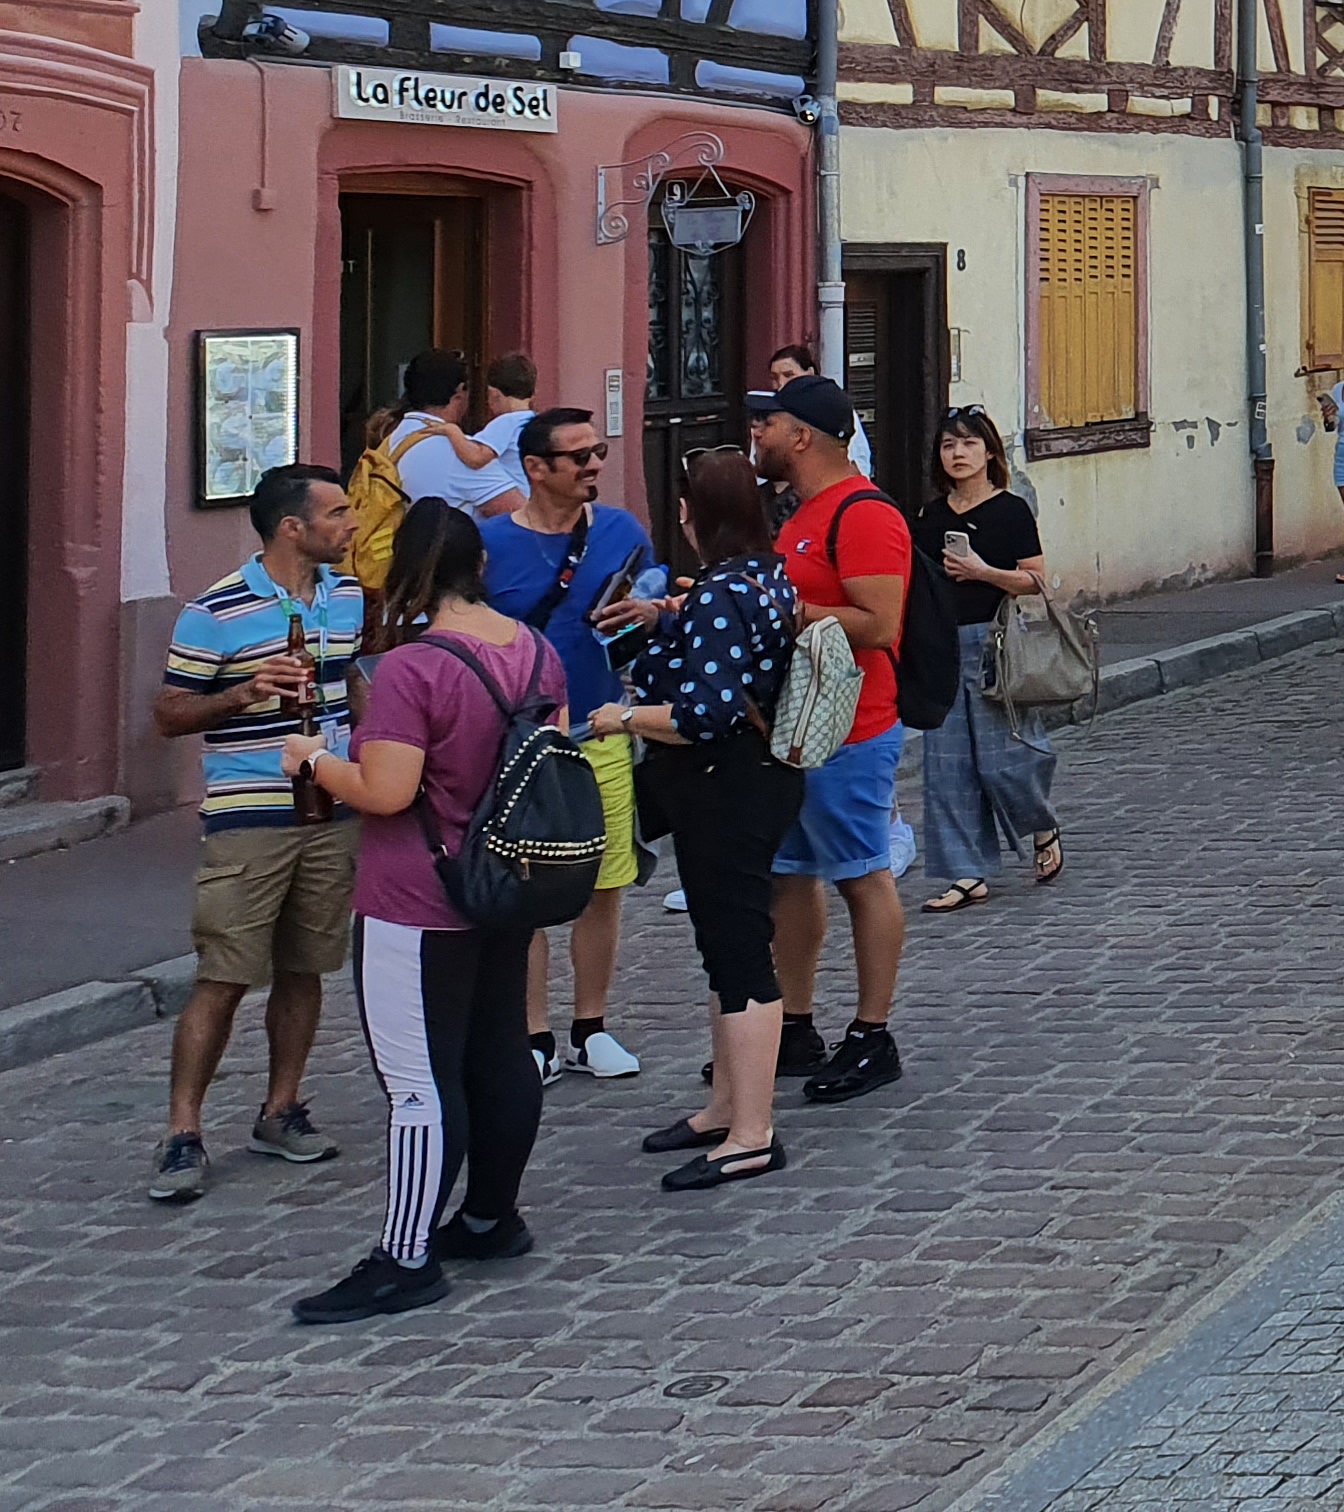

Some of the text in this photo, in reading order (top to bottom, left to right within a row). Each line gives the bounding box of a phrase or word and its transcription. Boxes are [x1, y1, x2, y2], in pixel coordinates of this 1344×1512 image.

[355, 71, 552, 118] La Fleur de Sel
[672, 183, 681, 201] 9
[957, 248, 966, 272] 8
